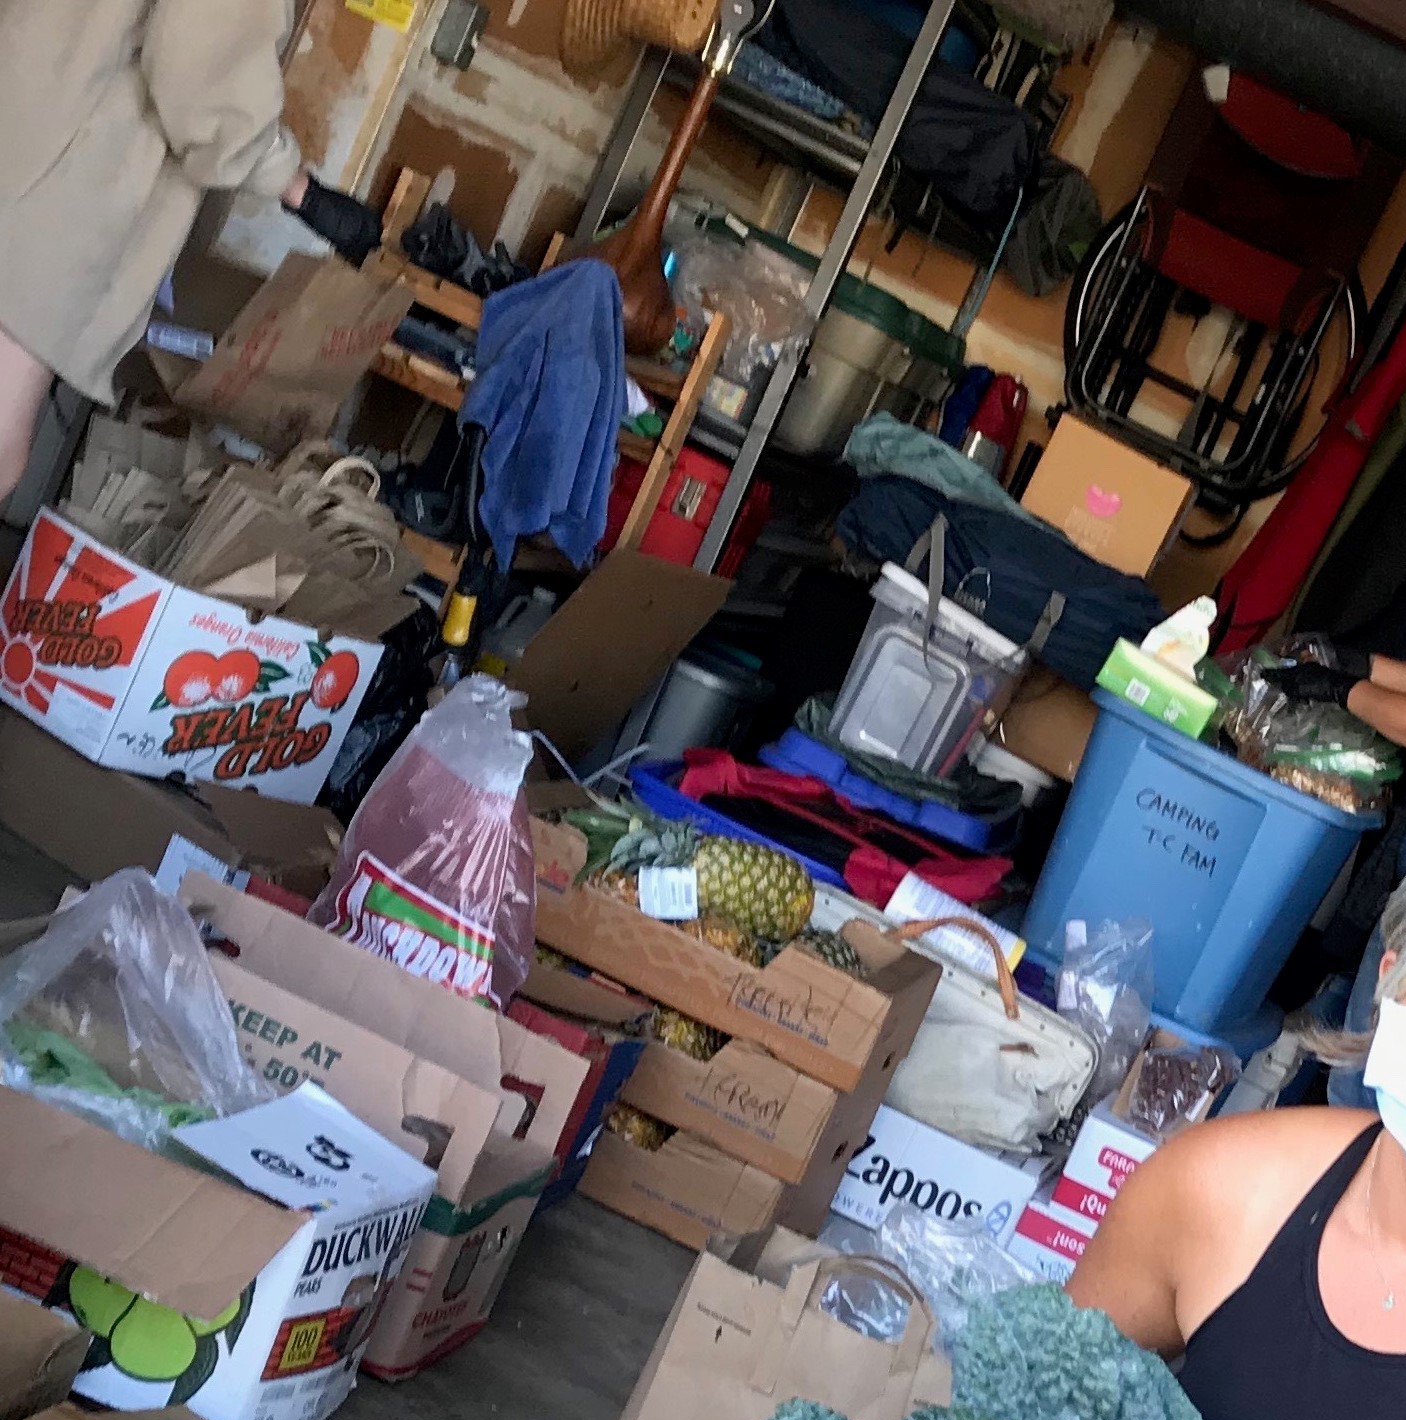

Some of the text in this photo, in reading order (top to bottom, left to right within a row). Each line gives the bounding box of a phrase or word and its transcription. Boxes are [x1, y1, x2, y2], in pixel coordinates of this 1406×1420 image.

[9, 600, 100, 636] FEVER
[188, 612, 300, 661] California Oranges
[36, 635, 120, 671] GOLD
[162, 690, 309, 757] FEVER
[212, 722, 331, 779] GOLD
[1136, 787, 1221, 841] CAMPING
[1180, 840, 1217, 878] FAM
[300, 1038, 342, 1071] AT
[846, 1134, 984, 1224] Zappos
[302, 1202, 428, 1277] DUCKWALL
[288, 1324, 320, 1351] 100
